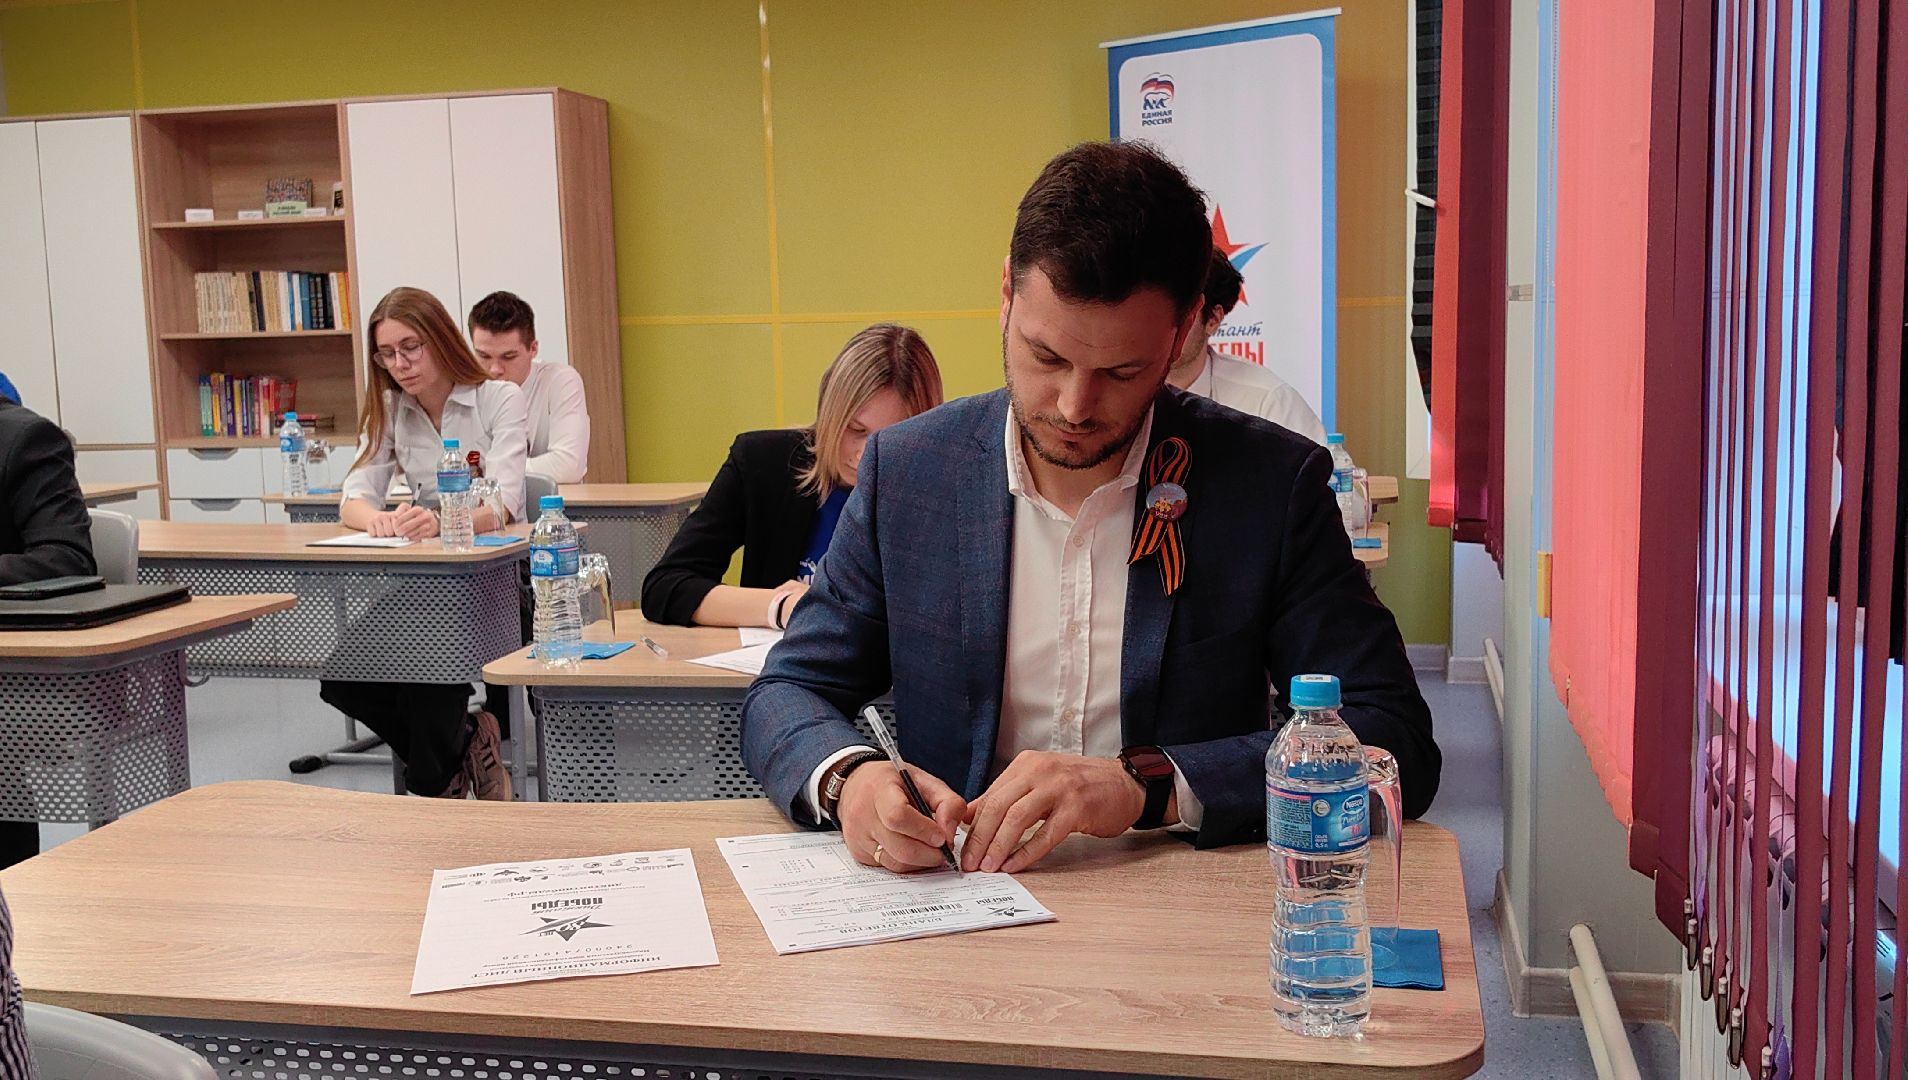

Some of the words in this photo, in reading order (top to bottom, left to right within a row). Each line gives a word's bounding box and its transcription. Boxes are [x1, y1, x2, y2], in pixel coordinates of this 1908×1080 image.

[1142, 110, 1172, 119] ЕДИНАЯ
[1142, 117, 1172, 127] РОССИЯ
[1213, 321, 1263, 337] тант
[531, 896, 602, 909] ПОБЕДЫ
